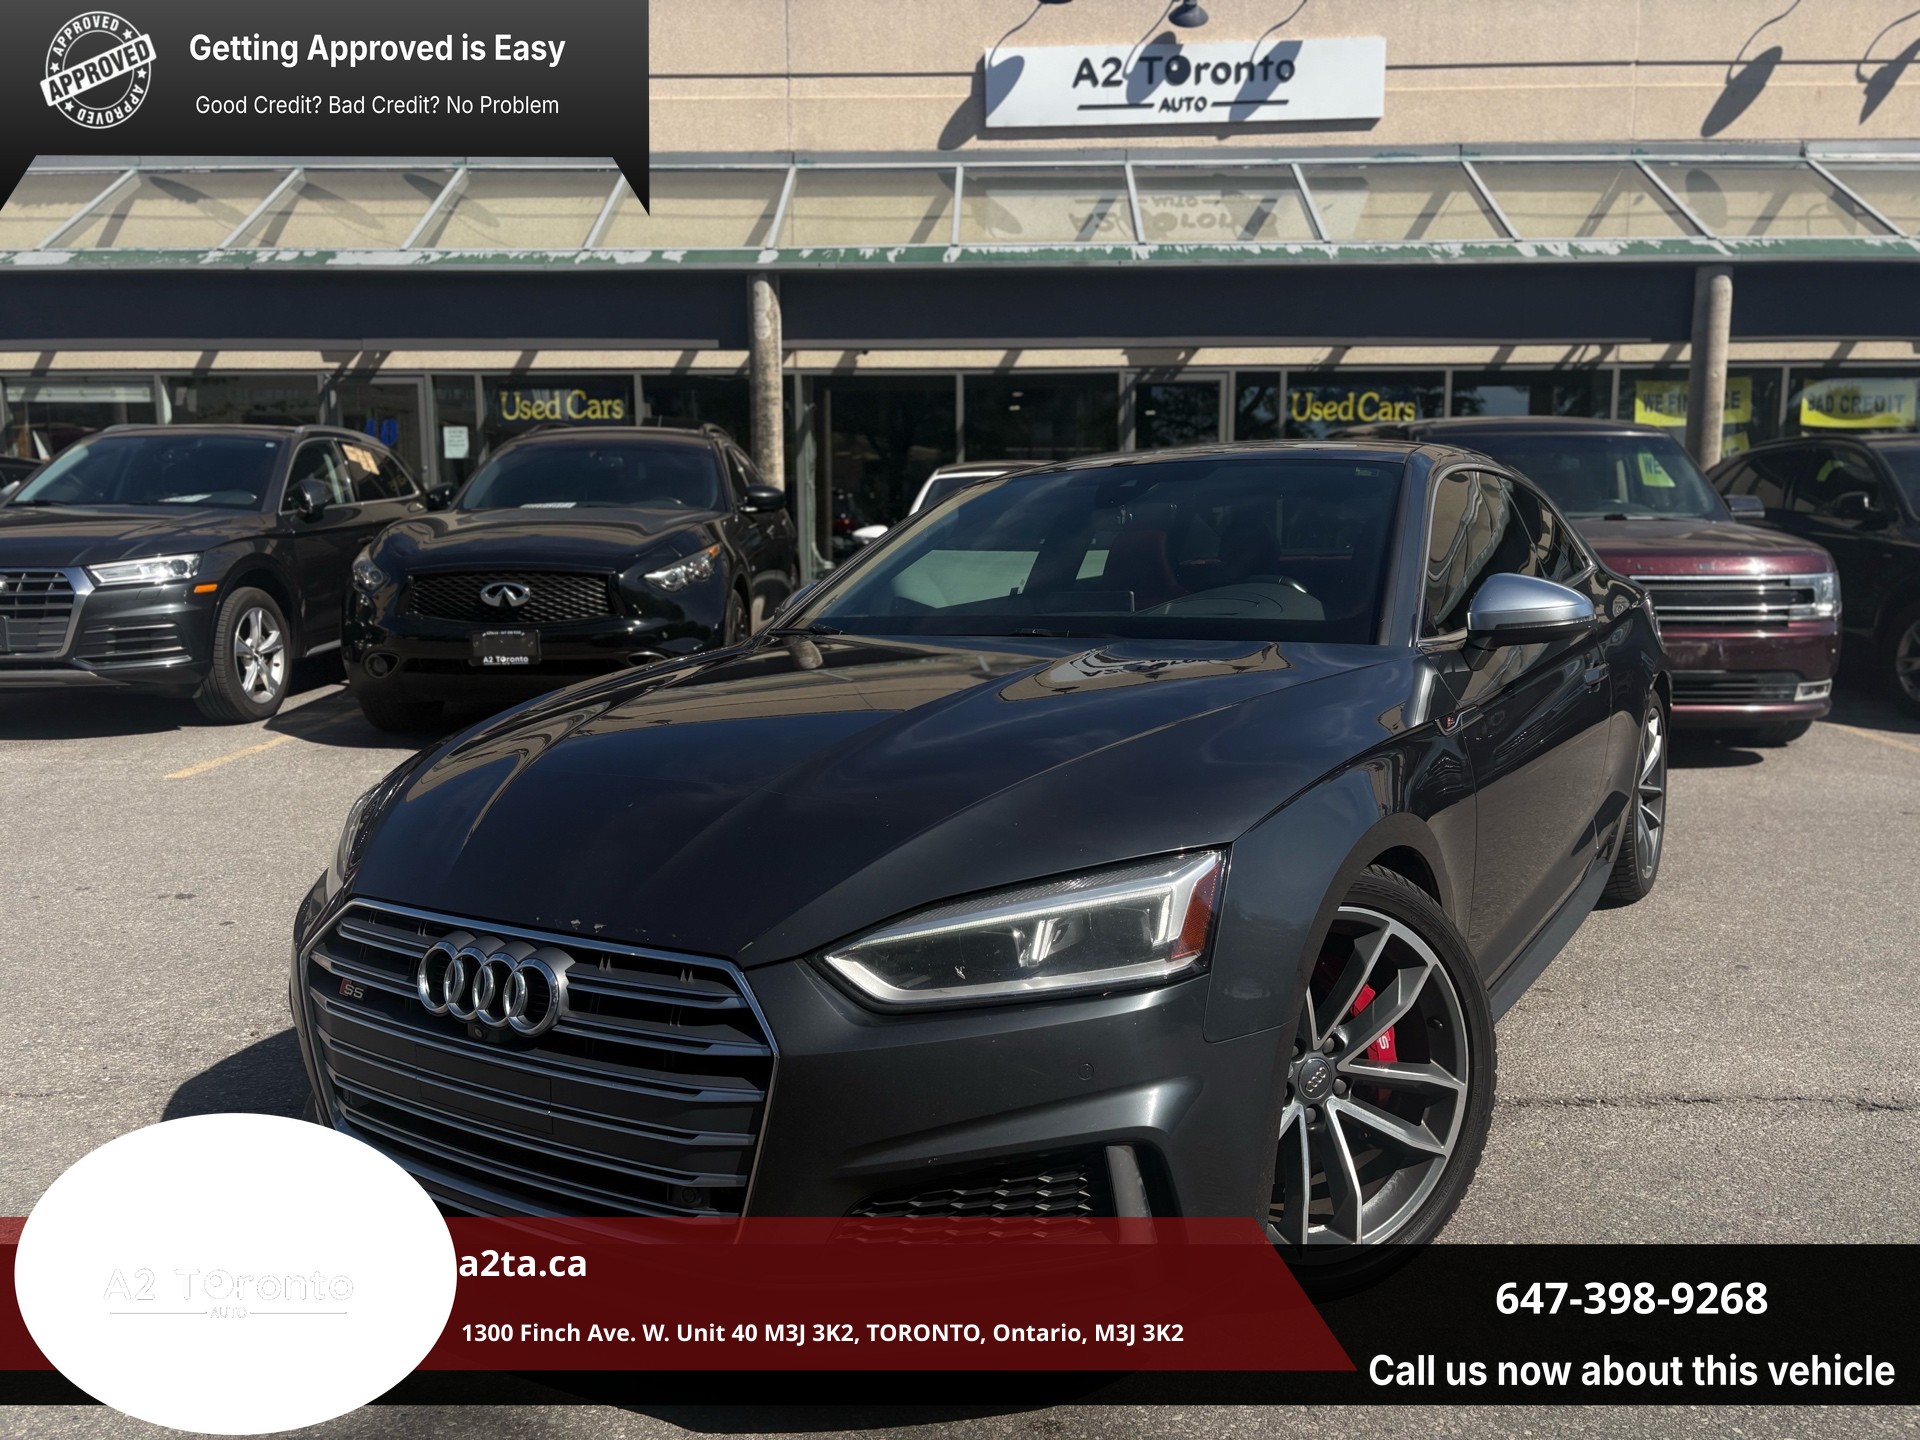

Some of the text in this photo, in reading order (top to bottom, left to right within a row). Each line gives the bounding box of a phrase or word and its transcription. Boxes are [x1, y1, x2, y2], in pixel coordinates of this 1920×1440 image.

[1072, 56, 1123, 88] A2
[1158, 96, 1208, 113] AUTO
[501, 389, 625, 421] Used Cars
[1291, 391, 1416, 422] Used Cars
[1808, 393, 1905, 414] BAD CREDIT
[343, 983, 365, 999] S5
